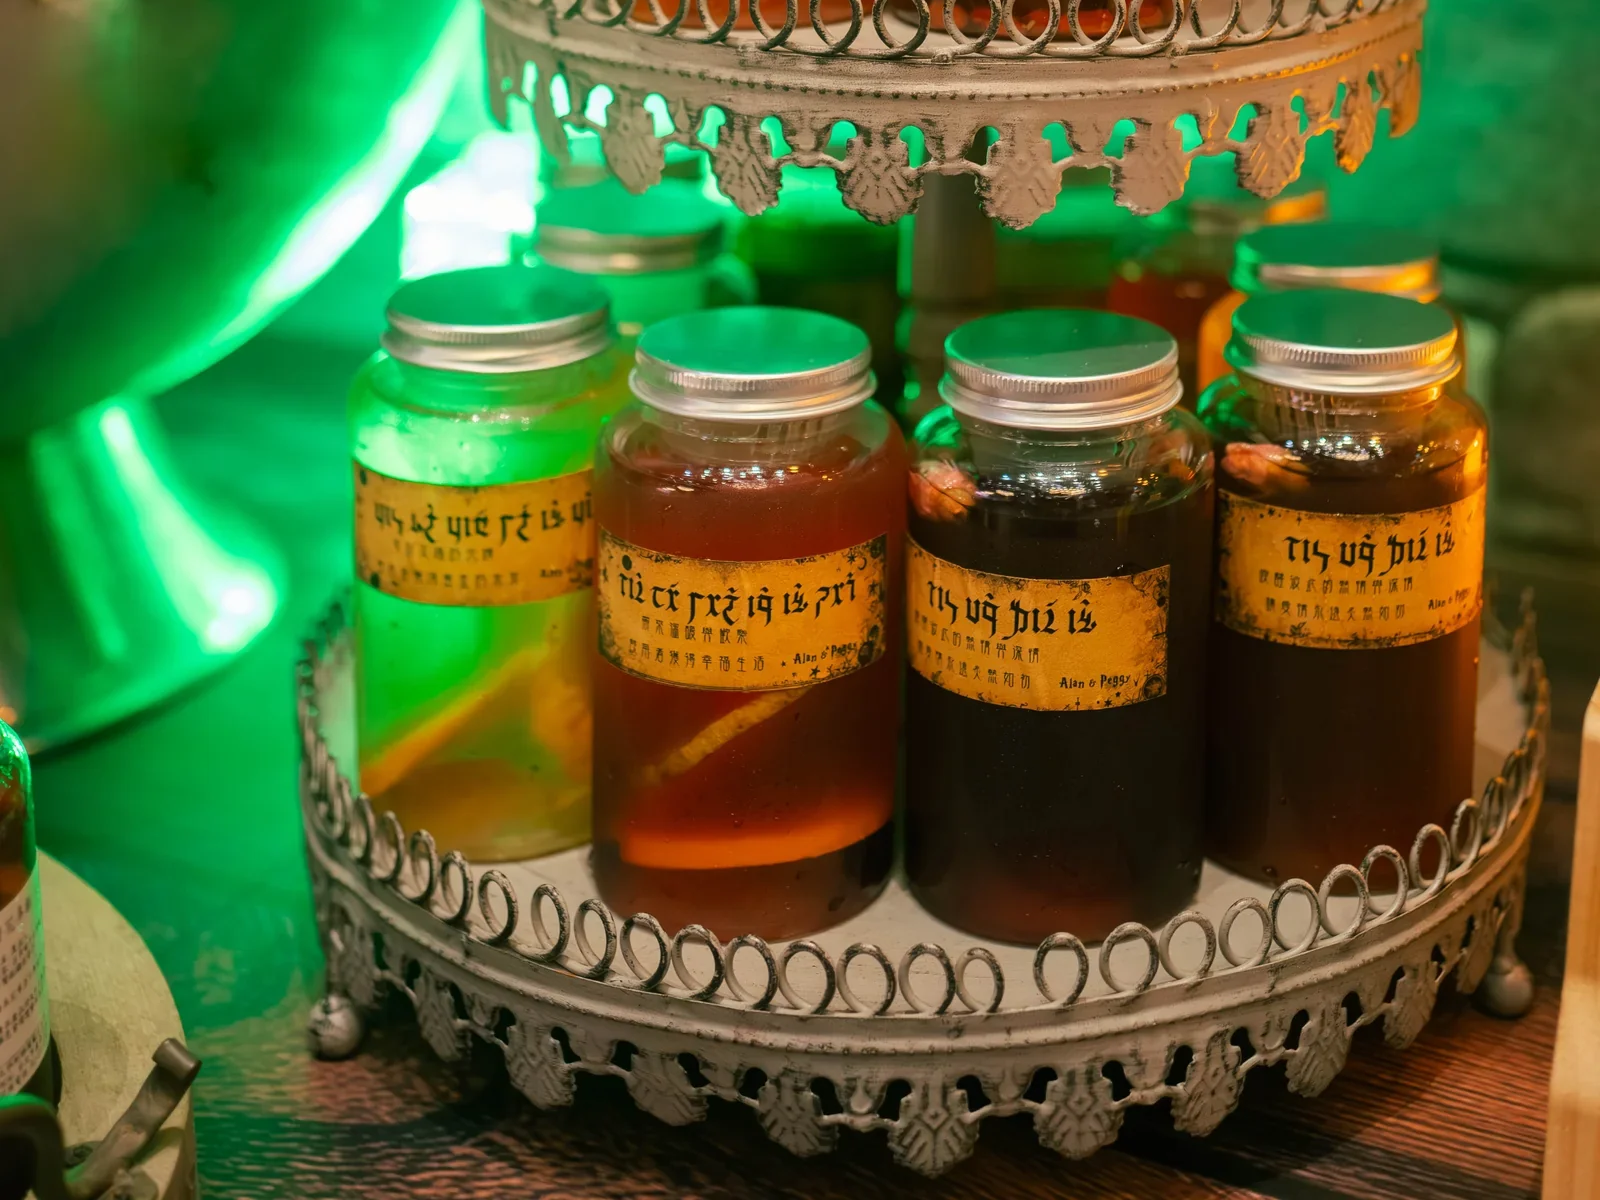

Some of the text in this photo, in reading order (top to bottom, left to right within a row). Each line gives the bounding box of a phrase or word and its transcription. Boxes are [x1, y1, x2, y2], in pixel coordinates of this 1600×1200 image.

[793, 653, 817, 665] Alan
[1059, 673, 1131, 689] Alan & Peggy
